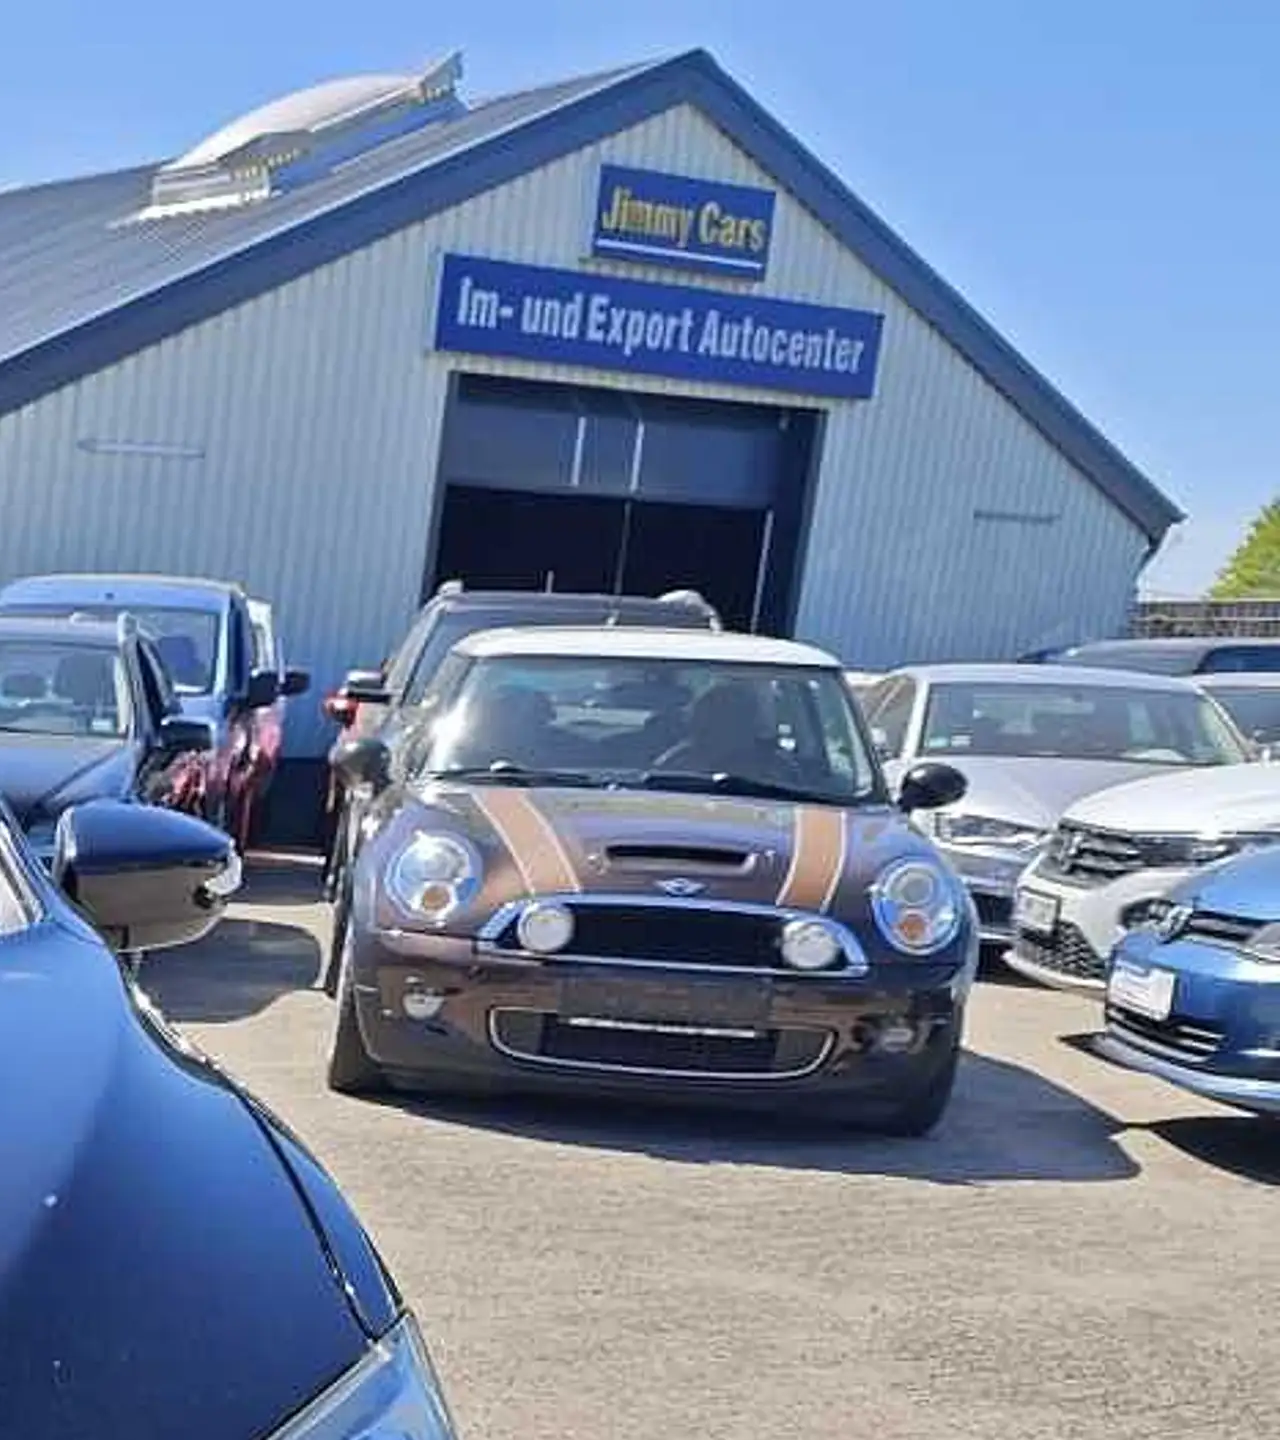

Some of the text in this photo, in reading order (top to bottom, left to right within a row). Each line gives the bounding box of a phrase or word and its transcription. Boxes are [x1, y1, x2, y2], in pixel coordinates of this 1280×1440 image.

[602, 186, 766, 252] Jimmy Cars
[457, 276, 865, 374] Im- und Export Autocenter
